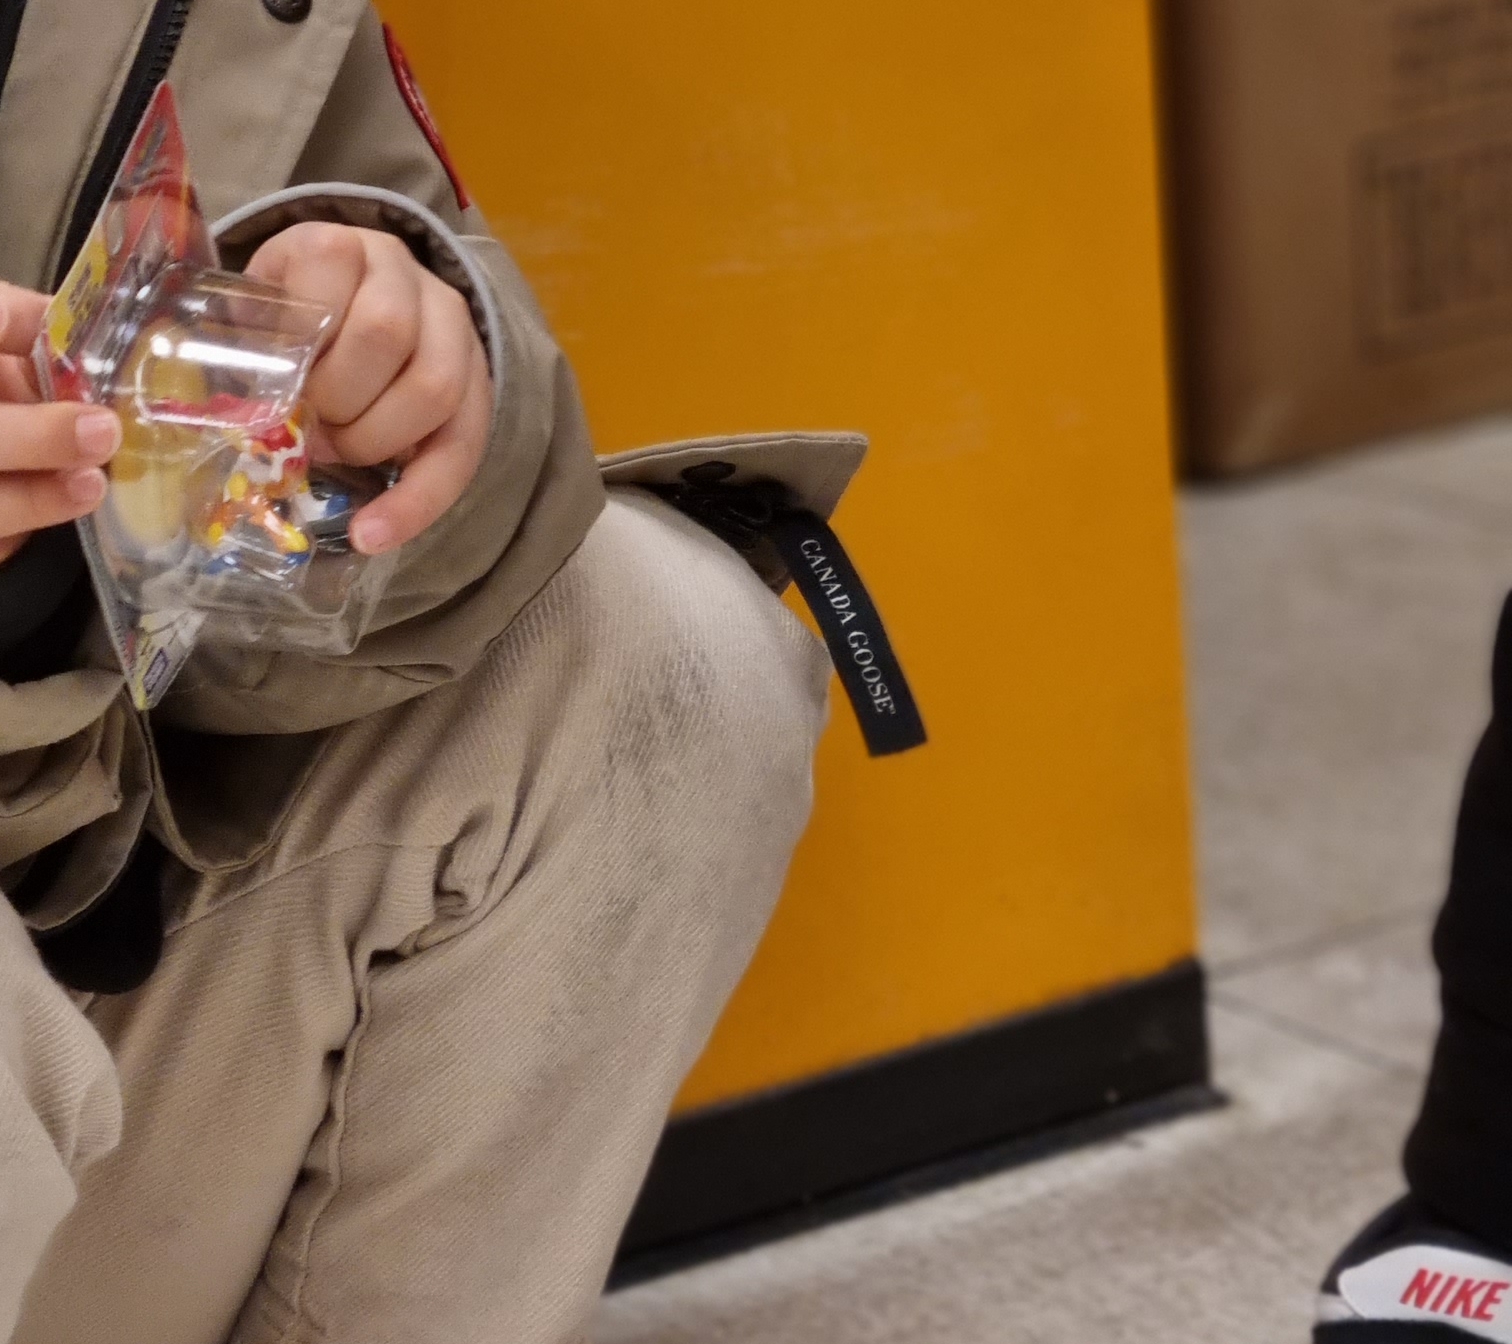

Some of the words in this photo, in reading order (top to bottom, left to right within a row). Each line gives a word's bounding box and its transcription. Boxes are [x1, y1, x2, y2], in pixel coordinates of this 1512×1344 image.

[799, 538, 858, 626] CANADA
[847, 630, 894, 714] GOOSE
[1399, 1267, 1511, 1323] NIKE
